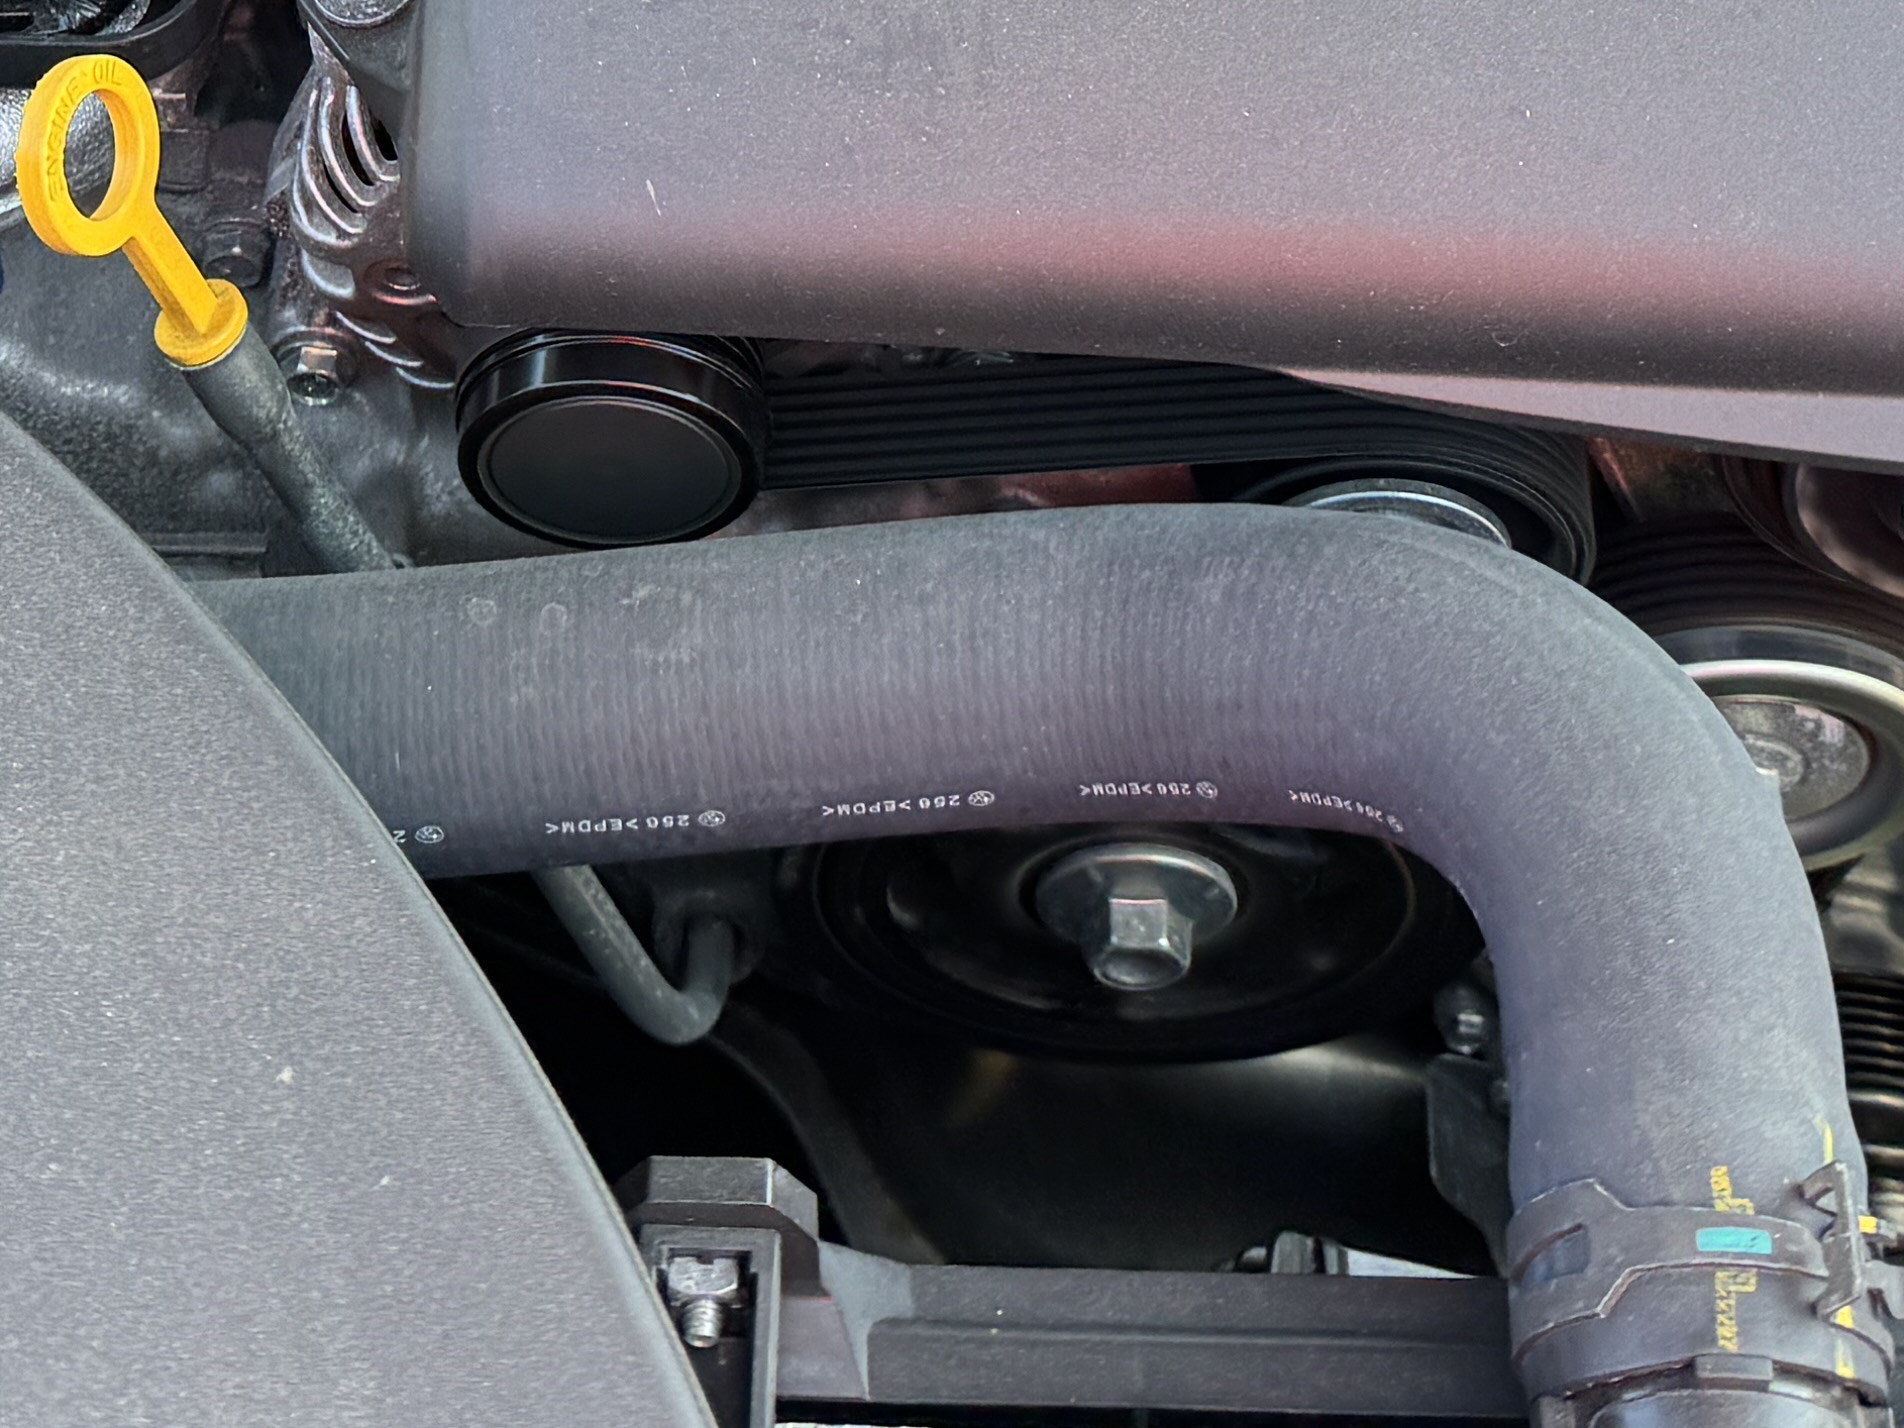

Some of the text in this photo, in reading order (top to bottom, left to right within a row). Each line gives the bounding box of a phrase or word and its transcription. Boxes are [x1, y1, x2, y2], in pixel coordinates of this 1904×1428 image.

[46, 59, 123, 202] ENGINE OIL
[821, 798, 911, 817] >EPDM<
[546, 817, 638, 835] >EPDM<
